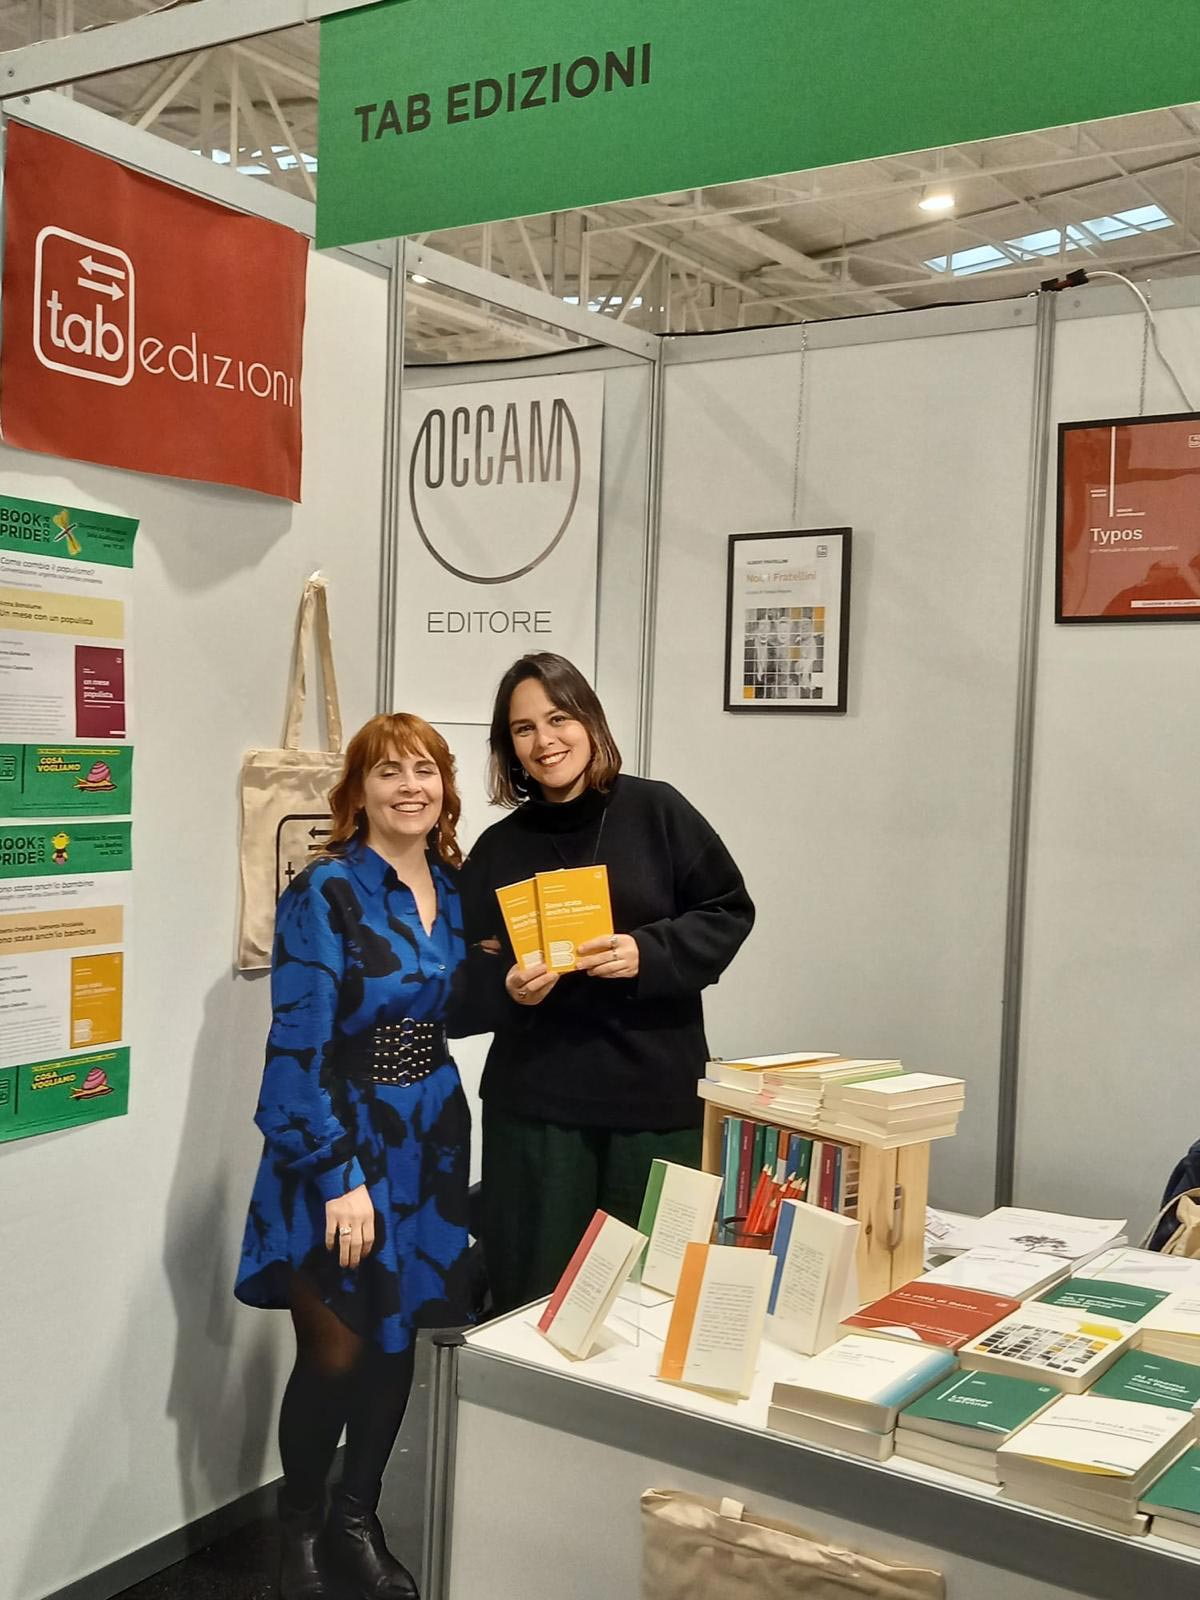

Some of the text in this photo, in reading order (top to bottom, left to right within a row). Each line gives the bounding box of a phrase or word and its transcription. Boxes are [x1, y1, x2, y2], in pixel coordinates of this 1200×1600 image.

[353, 42, 651, 143] TAB EDIZIONI
[46, 289, 295, 408] tab edizioni
[424, 397, 565, 490] OCCAM
[0, 508, 42, 527] BOOK
[0, 524, 42, 542] PRIDE
[1089, 527, 1144, 546] Typos
[11, 611, 32, 620] mese
[34, 613, 47, 621] con
[60, 616, 94, 626] populista
[427, 610, 552, 633] EDITORE
[40, 756, 64, 765] COSA
[0, 836, 37, 851] OOK
[0, 851, 36, 866] RIDE
[0, 886, 13, 894] ono
[0, 936, 13, 944] ono
[34, 1071, 59, 1082] COSA
